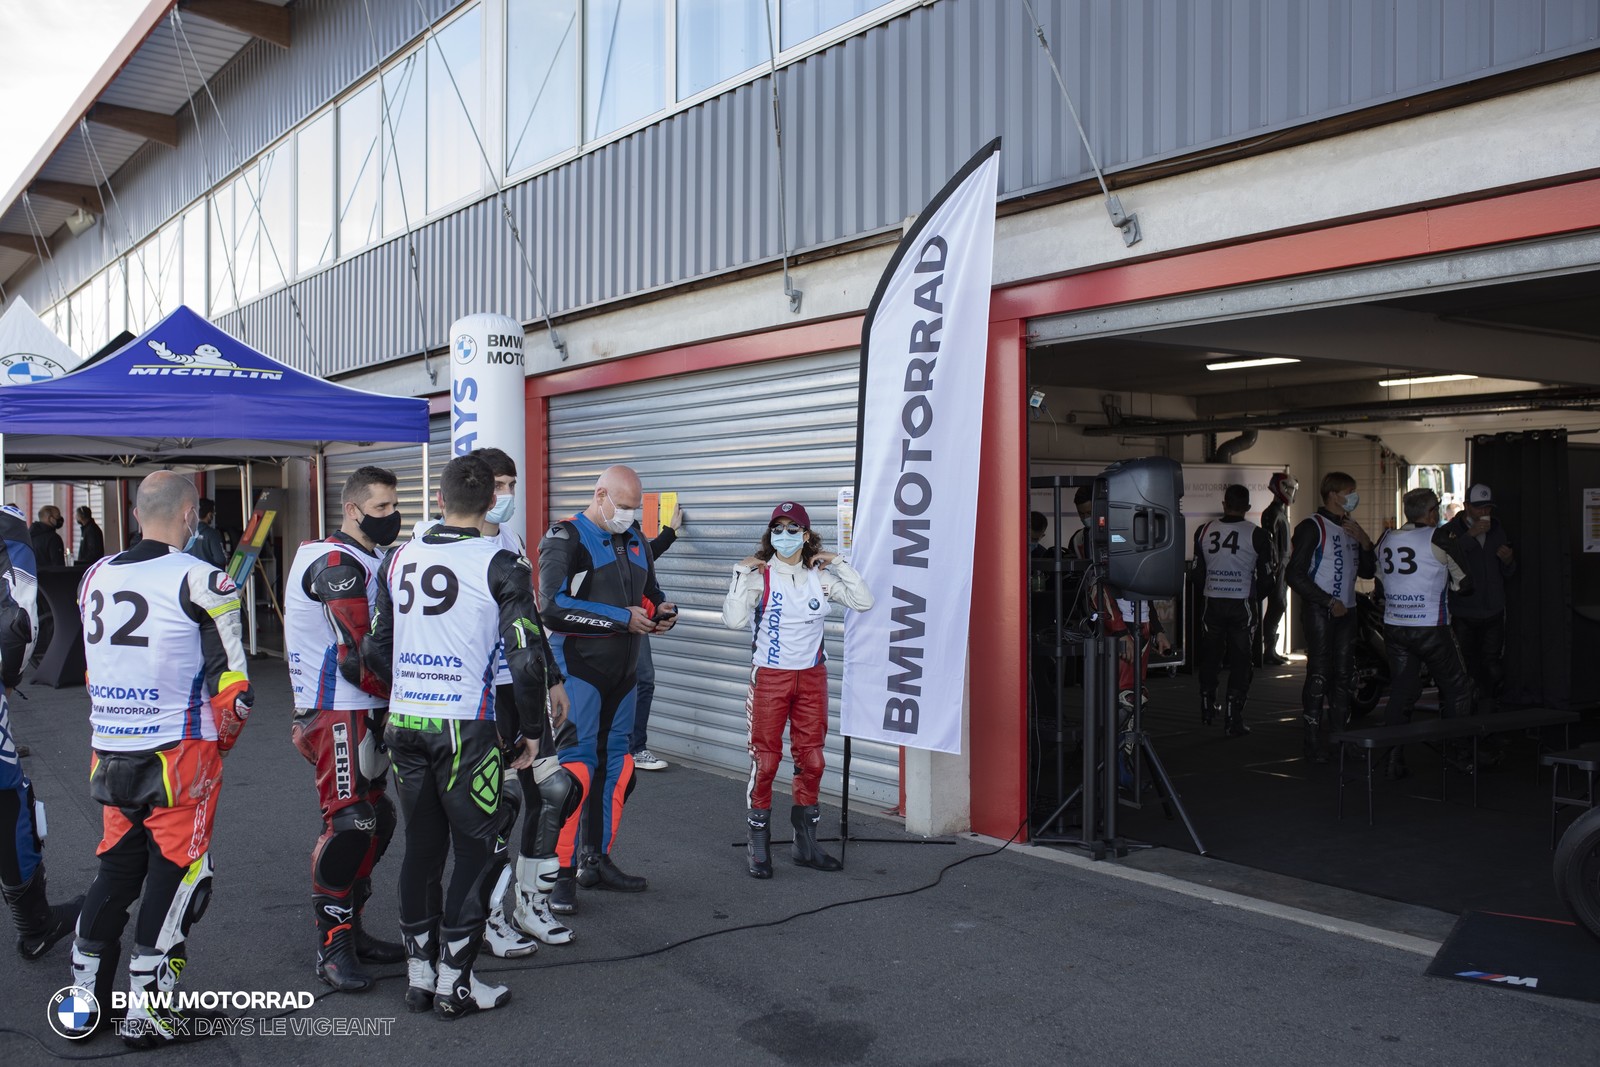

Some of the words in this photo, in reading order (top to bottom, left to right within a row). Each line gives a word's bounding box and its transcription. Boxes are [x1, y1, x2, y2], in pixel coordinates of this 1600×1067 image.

[487, 334, 523, 349] BMW
[1, 355, 57, 369] BMW
[128, 367, 284, 381] MICHELIN
[892, 234, 948, 569] MOTORRAD
[453, 376, 478, 458] AYS
[1208, 530, 1240, 555] 34
[1332, 535, 1343, 597] RACKDAYS
[1383, 546, 1418, 575] 33
[399, 562, 459, 616] 59
[87, 589, 149, 647] 32
[564, 614, 614, 629] DAINESE
[767, 591, 784, 665] TRACKDAYS
[399, 652, 463, 668] RACKDAYS
[882, 585, 927, 735] BMW
[401, 670, 415, 678] BMW
[89, 684, 160, 701] RACKDAYS
[404, 691, 462, 702] MICHELIN
[107, 706, 160, 715] MOTORRAD
[96, 725, 160, 735] MICHELIN
